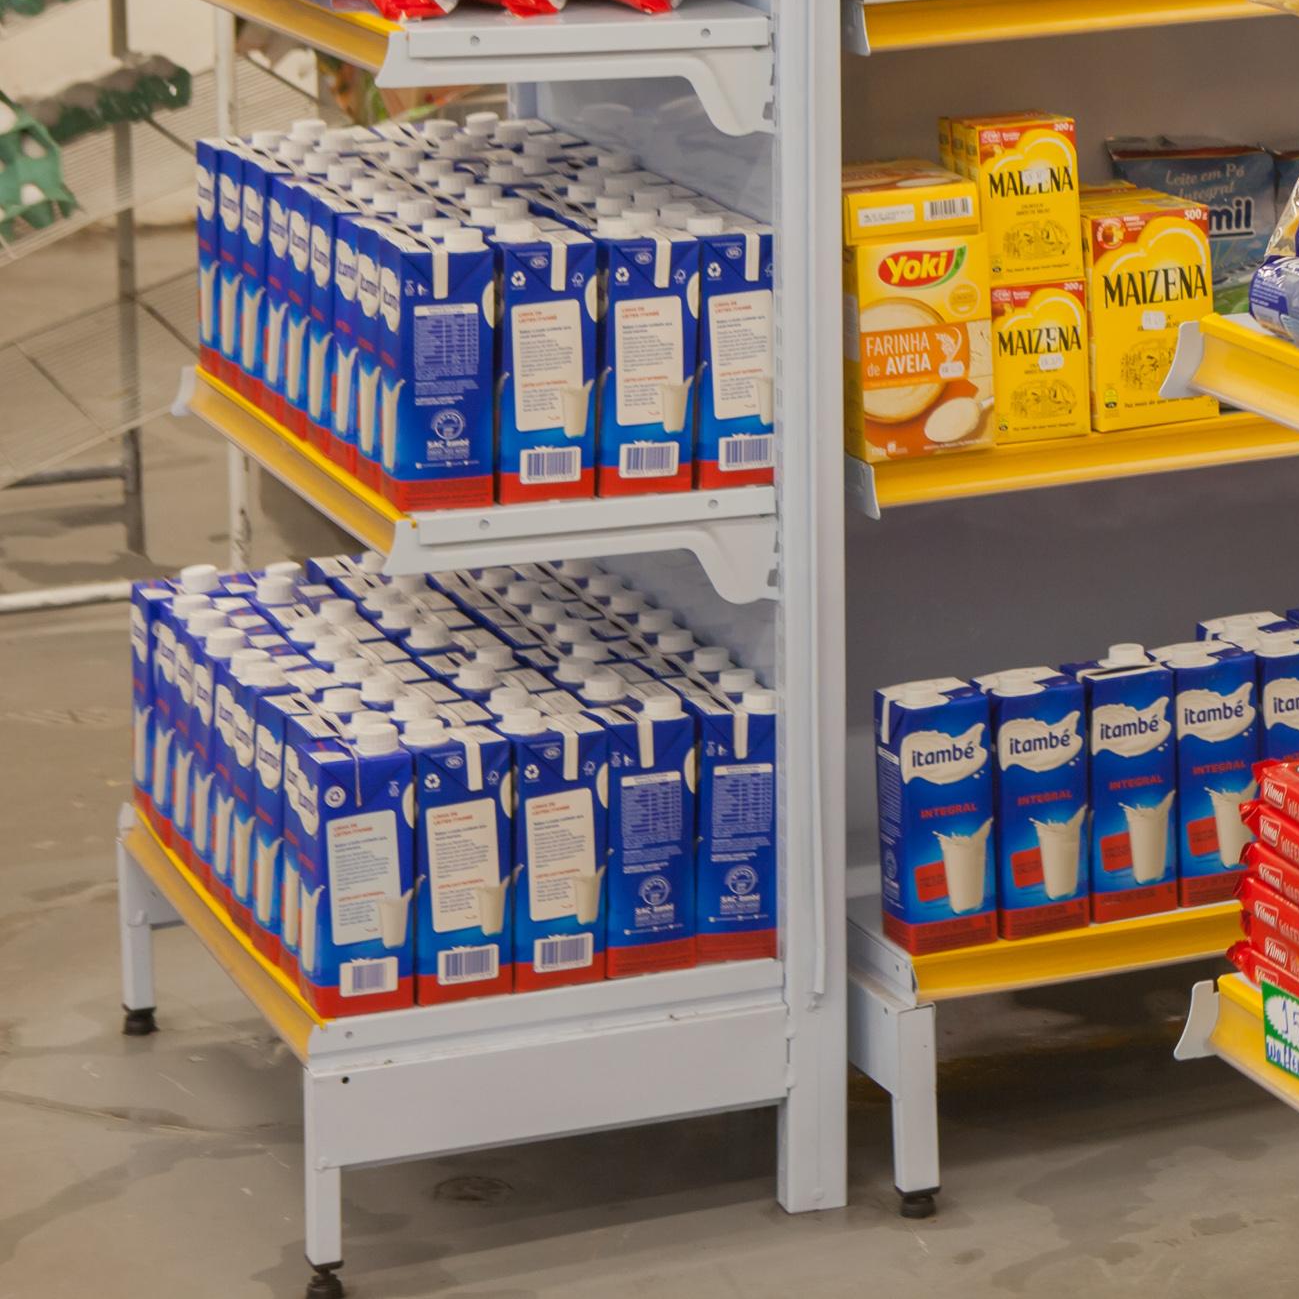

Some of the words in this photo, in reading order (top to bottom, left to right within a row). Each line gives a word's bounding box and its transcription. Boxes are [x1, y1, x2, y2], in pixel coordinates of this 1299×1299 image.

[1165, 169, 1199, 185] Leite
[1200, 171, 1222, 182] em
[1225, 163, 1246, 179] Pó
[884, 251, 949, 285] Yoki
[1100, 264, 1209, 310] MAIZENA
[865, 331, 931, 357] FARINHA
[996, 325, 1083, 358] MAIZENA
[867, 364, 881, 378] de
[885, 353, 932, 377] AVEIA
[1184, 699, 1246, 727] itambé
[1100, 714, 1161, 742] itambé
[911, 741, 976, 770] itambé
[1008, 730, 1072, 757] itambé
[1192, 760, 1247, 777] INTEGRAL
[1108, 775, 1165, 791] INTEGRAL
[1264, 781, 1286, 806] Vilma
[1017, 789, 1074, 806] INTEGRAL
[920, 803, 979, 819] INTEGRAL
[1260, 817, 1279, 842] Vilma
[1255, 902, 1277, 928] Vilma
